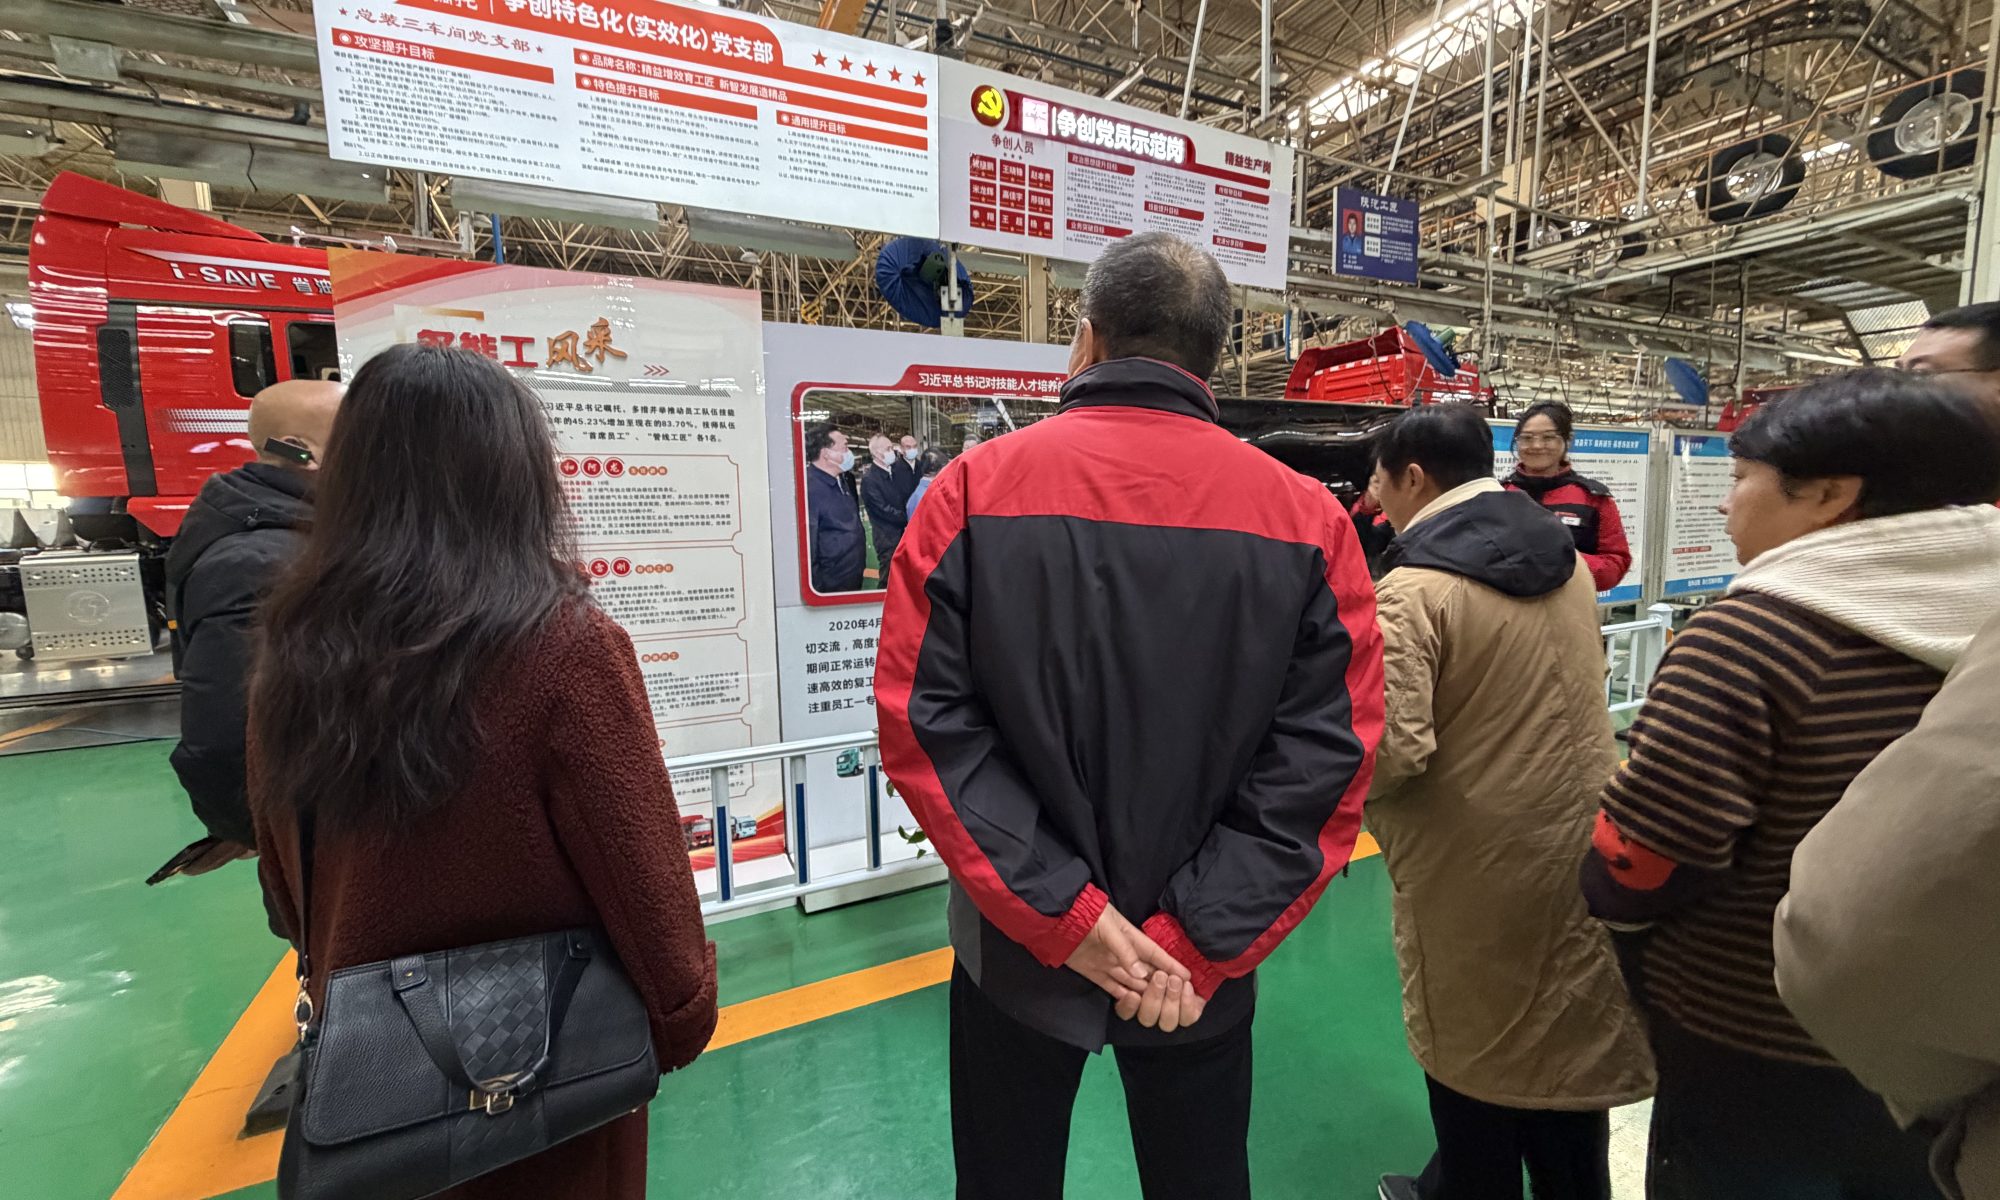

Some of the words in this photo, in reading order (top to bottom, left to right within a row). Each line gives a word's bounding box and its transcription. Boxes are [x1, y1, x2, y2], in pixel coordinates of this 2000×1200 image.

[354, 8, 531, 53] 总装三车间党支部
[354, 34, 436, 61] 攻坚提升目标
[593, 79, 660, 101] 特色提升目标
[791, 115, 846, 135] 通用提升目标
[991, 133, 1035, 155] 争创人员
[1057, 109, 1186, 164] 争创党员示范岗
[1225, 151, 1272, 175] 精益生产岗
[169, 263, 282, 290] i-SAVE
[806, 657, 876, 675] 期间正常运转
[807, 676, 875, 694] 速高效的复工
[808, 695, 876, 714] 注重员工一专
